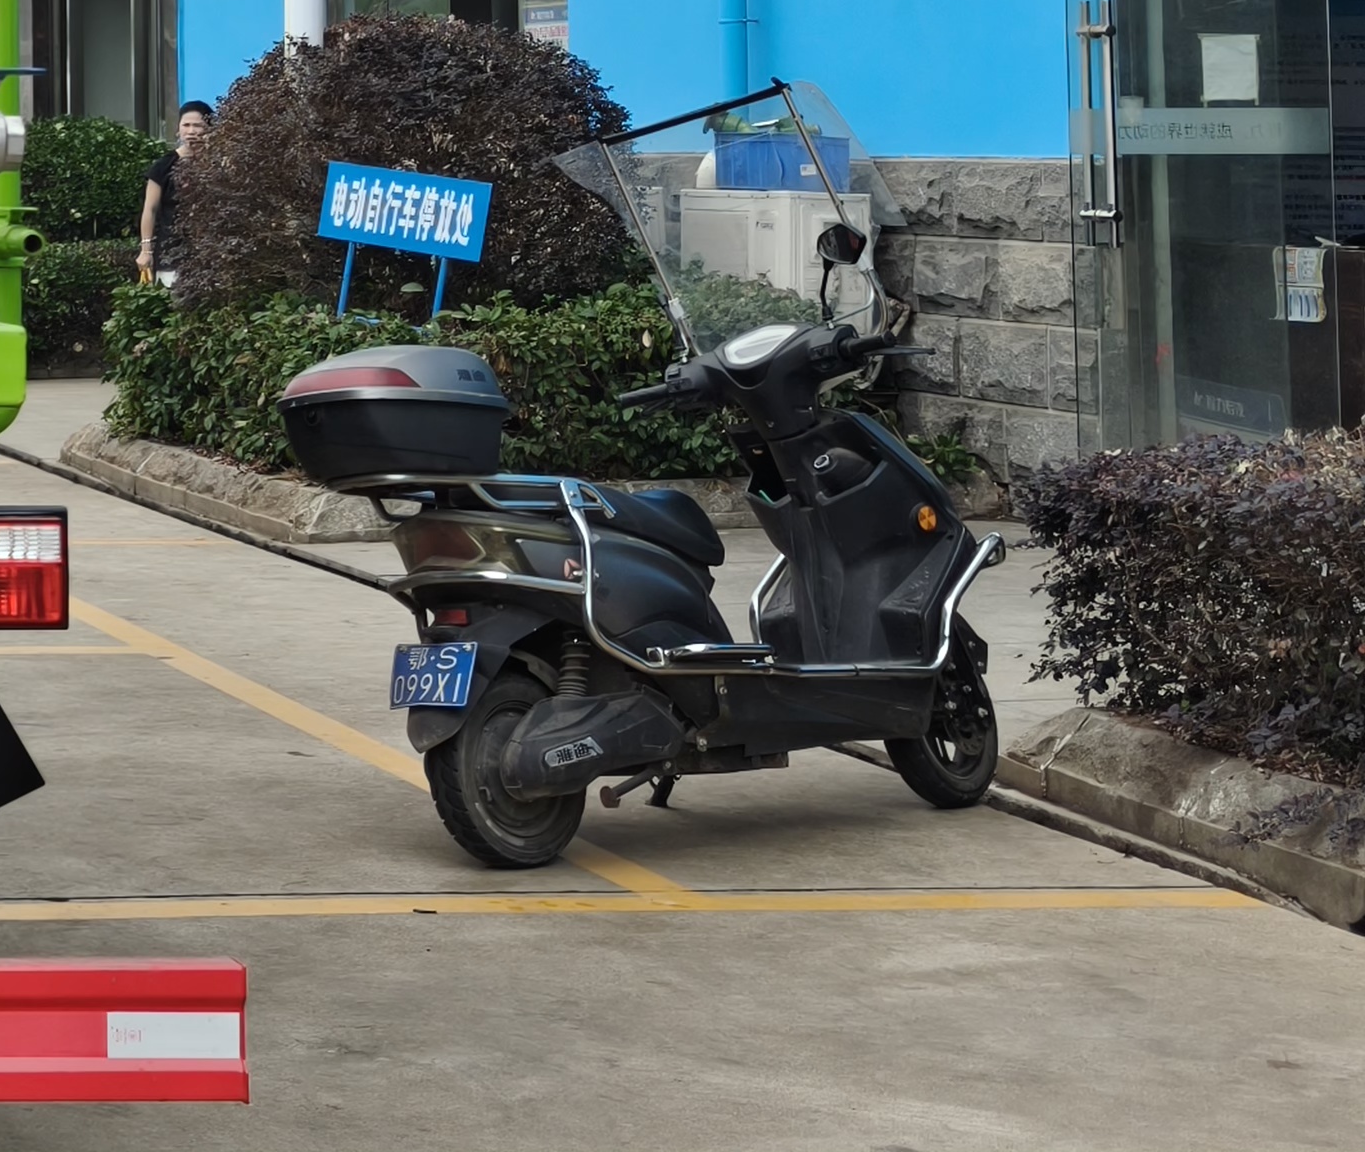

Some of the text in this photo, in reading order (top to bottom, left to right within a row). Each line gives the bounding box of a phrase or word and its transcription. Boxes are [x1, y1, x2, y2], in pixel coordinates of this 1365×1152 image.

[330, 173, 474, 247] 电动自行车停放处
